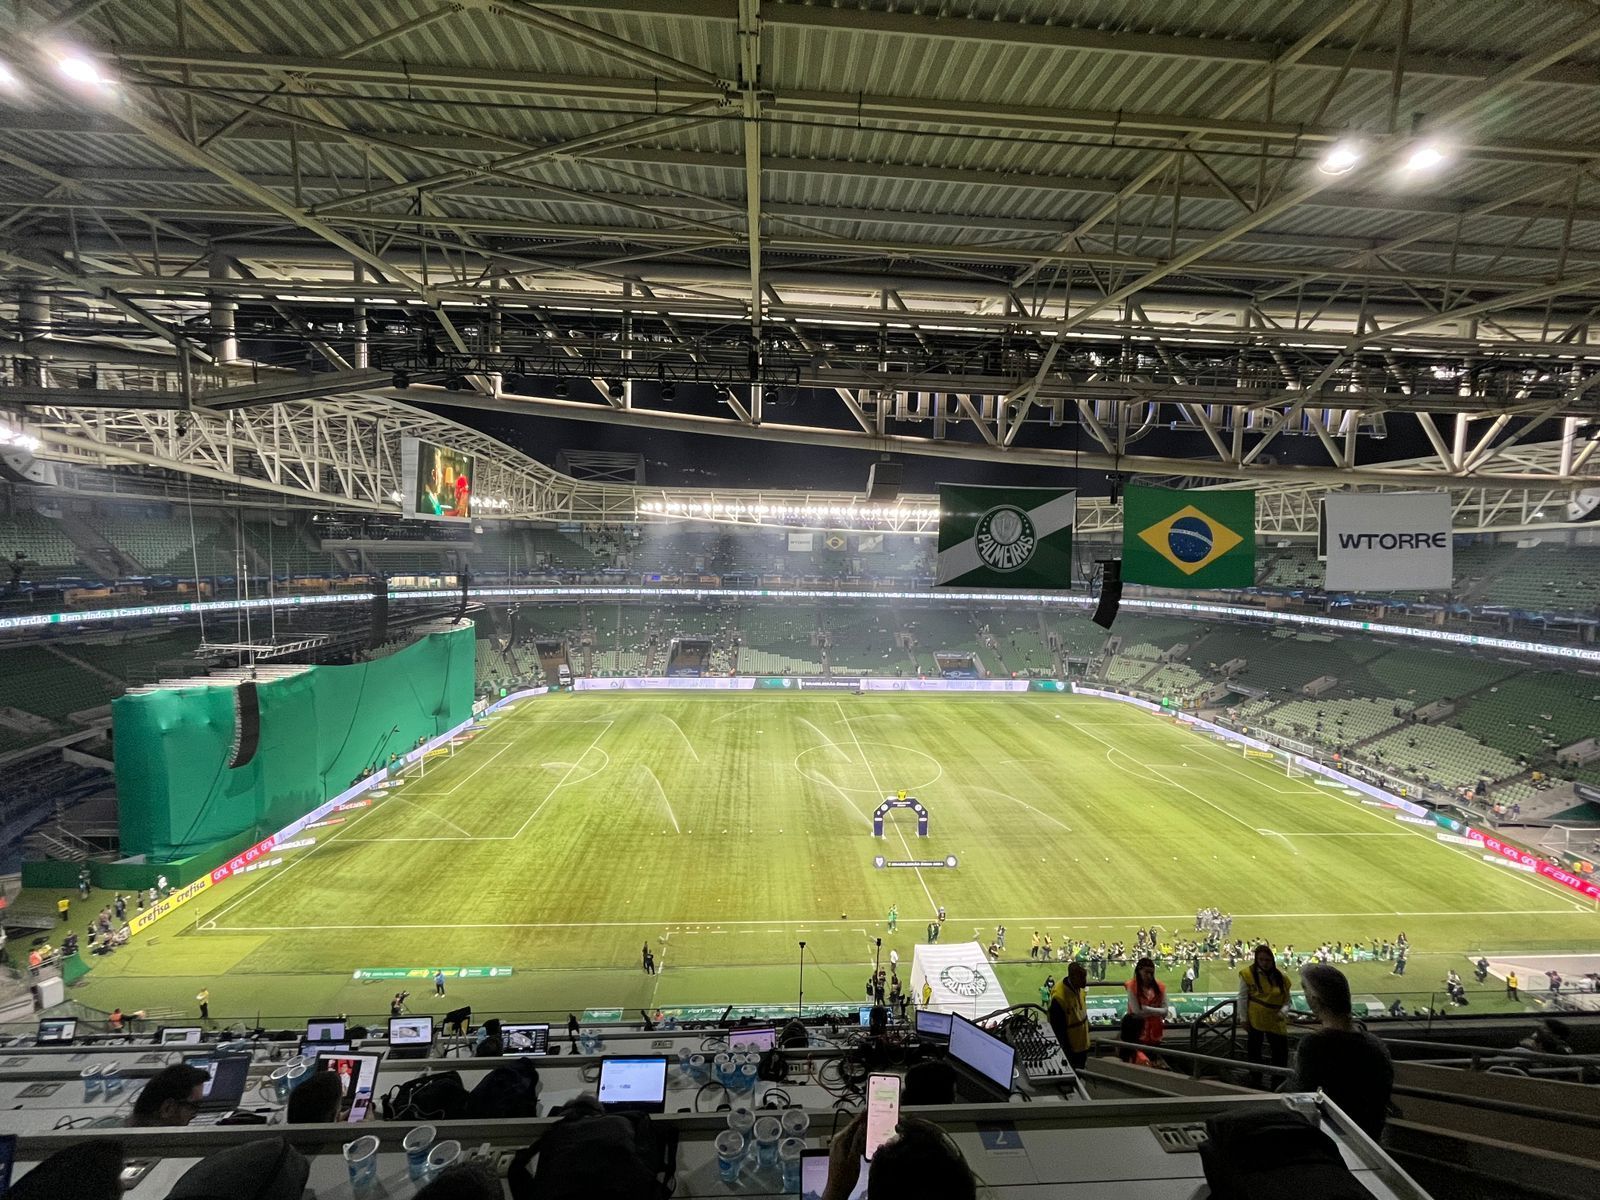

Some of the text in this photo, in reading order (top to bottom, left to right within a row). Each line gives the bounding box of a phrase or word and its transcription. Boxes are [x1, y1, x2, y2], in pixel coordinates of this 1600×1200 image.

[1338, 532, 1446, 549] WTORRE
[978, 533, 1034, 568] PALMEIRAS
[82, 611, 111, 619] vindos
[1497, 640, 1525, 649] vindos
[1535, 644, 1558, 654] Casa
[1560, 648, 1572, 656] do
[1471, 831, 1484, 842] GOL
[261, 839, 273, 852] GOL
[1487, 839, 1500, 850] GOL
[246, 849, 259, 861] GOL
[1503, 847, 1518, 859] GOL
[230, 858, 245, 870] GOL
[1521, 855, 1537, 868] GOL
[214, 867, 229, 880] GOL
[176, 880, 205, 903] crefisa
[138, 902, 170, 927] crefisa
